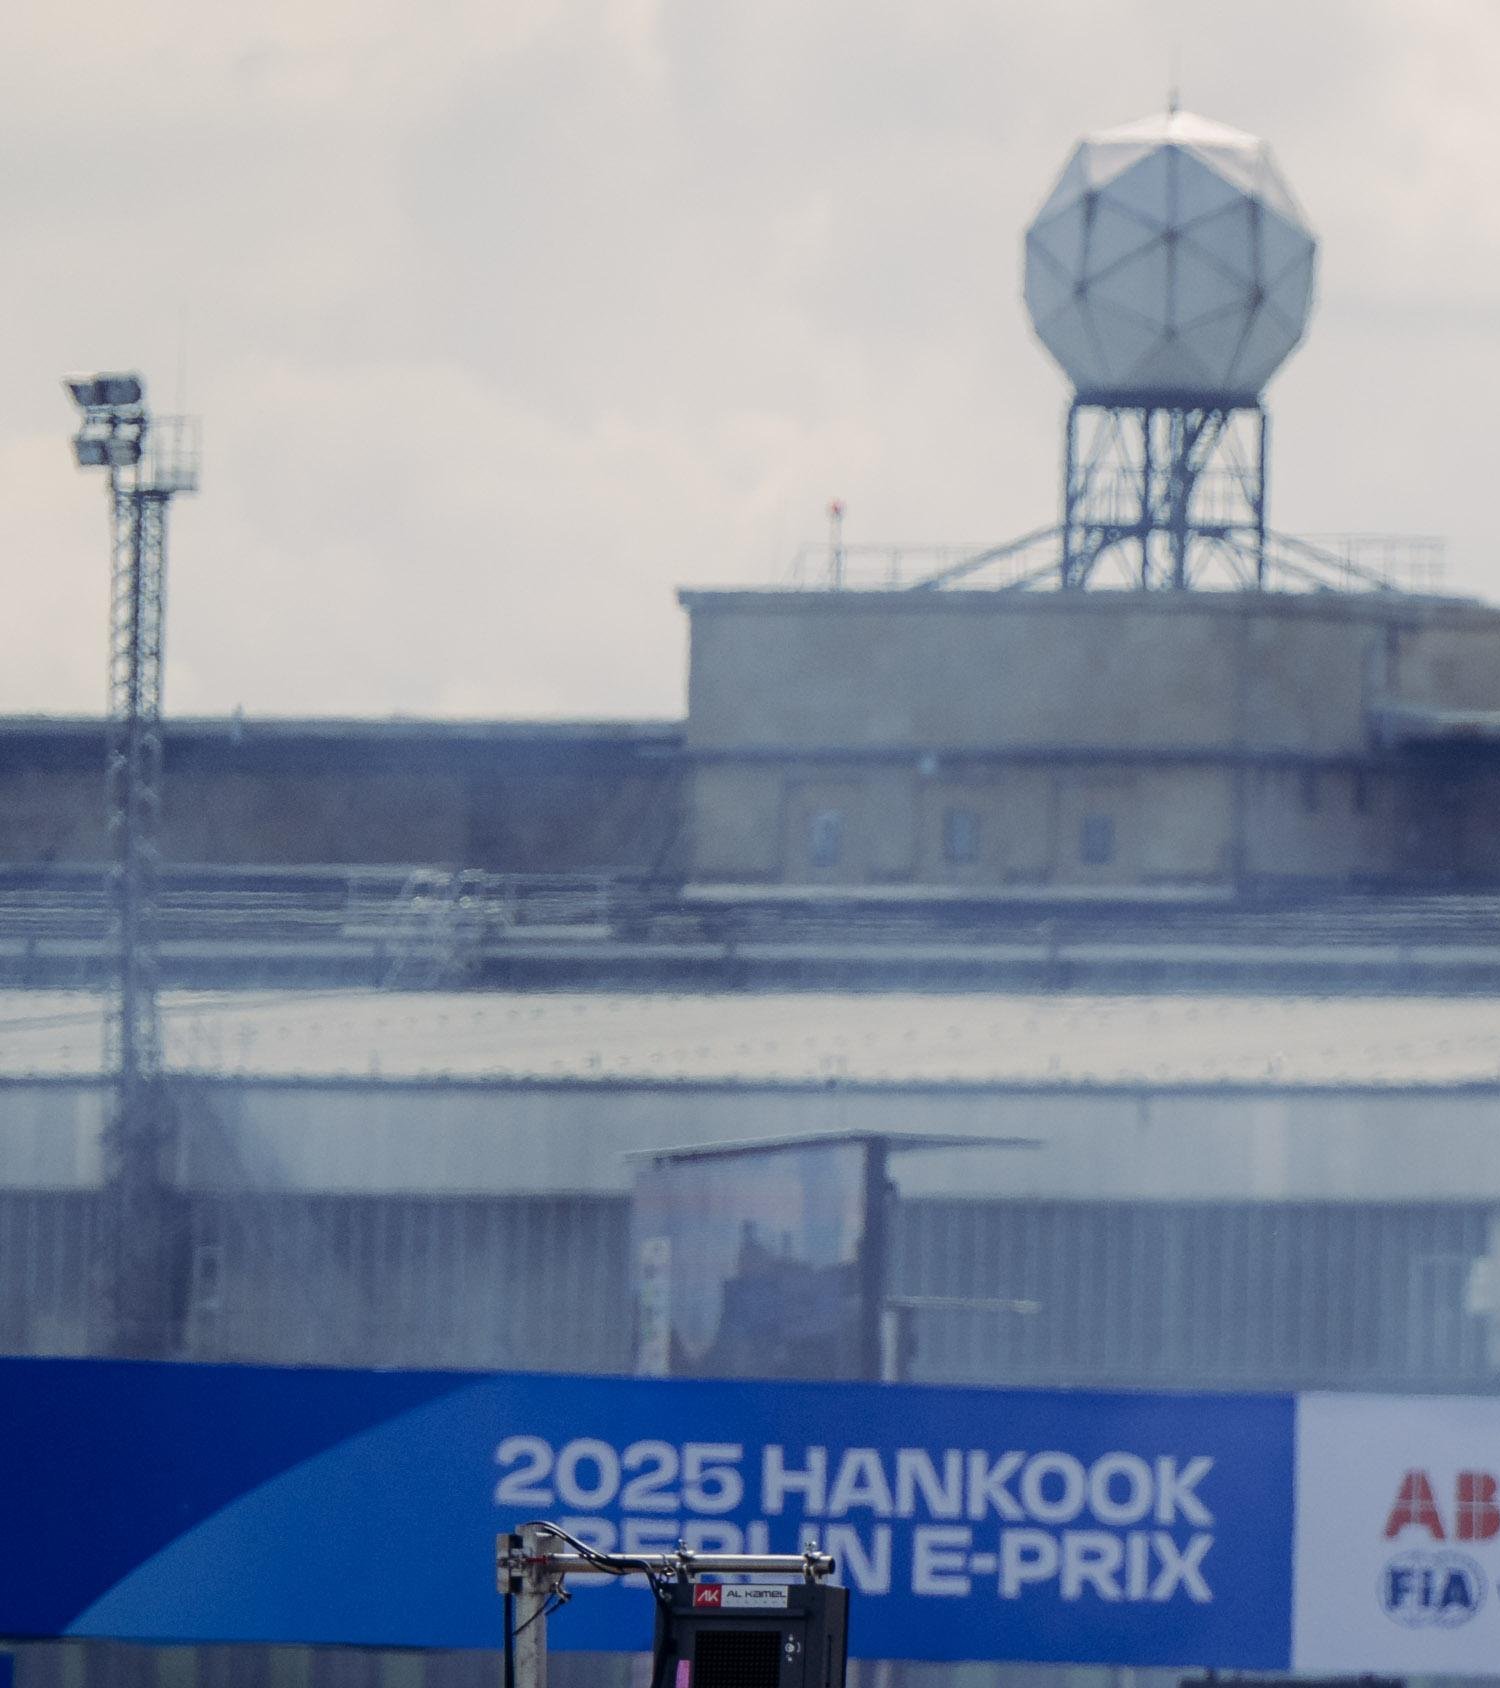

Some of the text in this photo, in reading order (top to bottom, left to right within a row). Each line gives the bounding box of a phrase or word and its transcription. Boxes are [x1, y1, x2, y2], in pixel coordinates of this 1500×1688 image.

[495, 1435, 1215, 1527] 2025 HANKOOK
[911, 1523, 1215, 1603] E-PRIX
[1386, 1567, 1474, 1608] FIA
